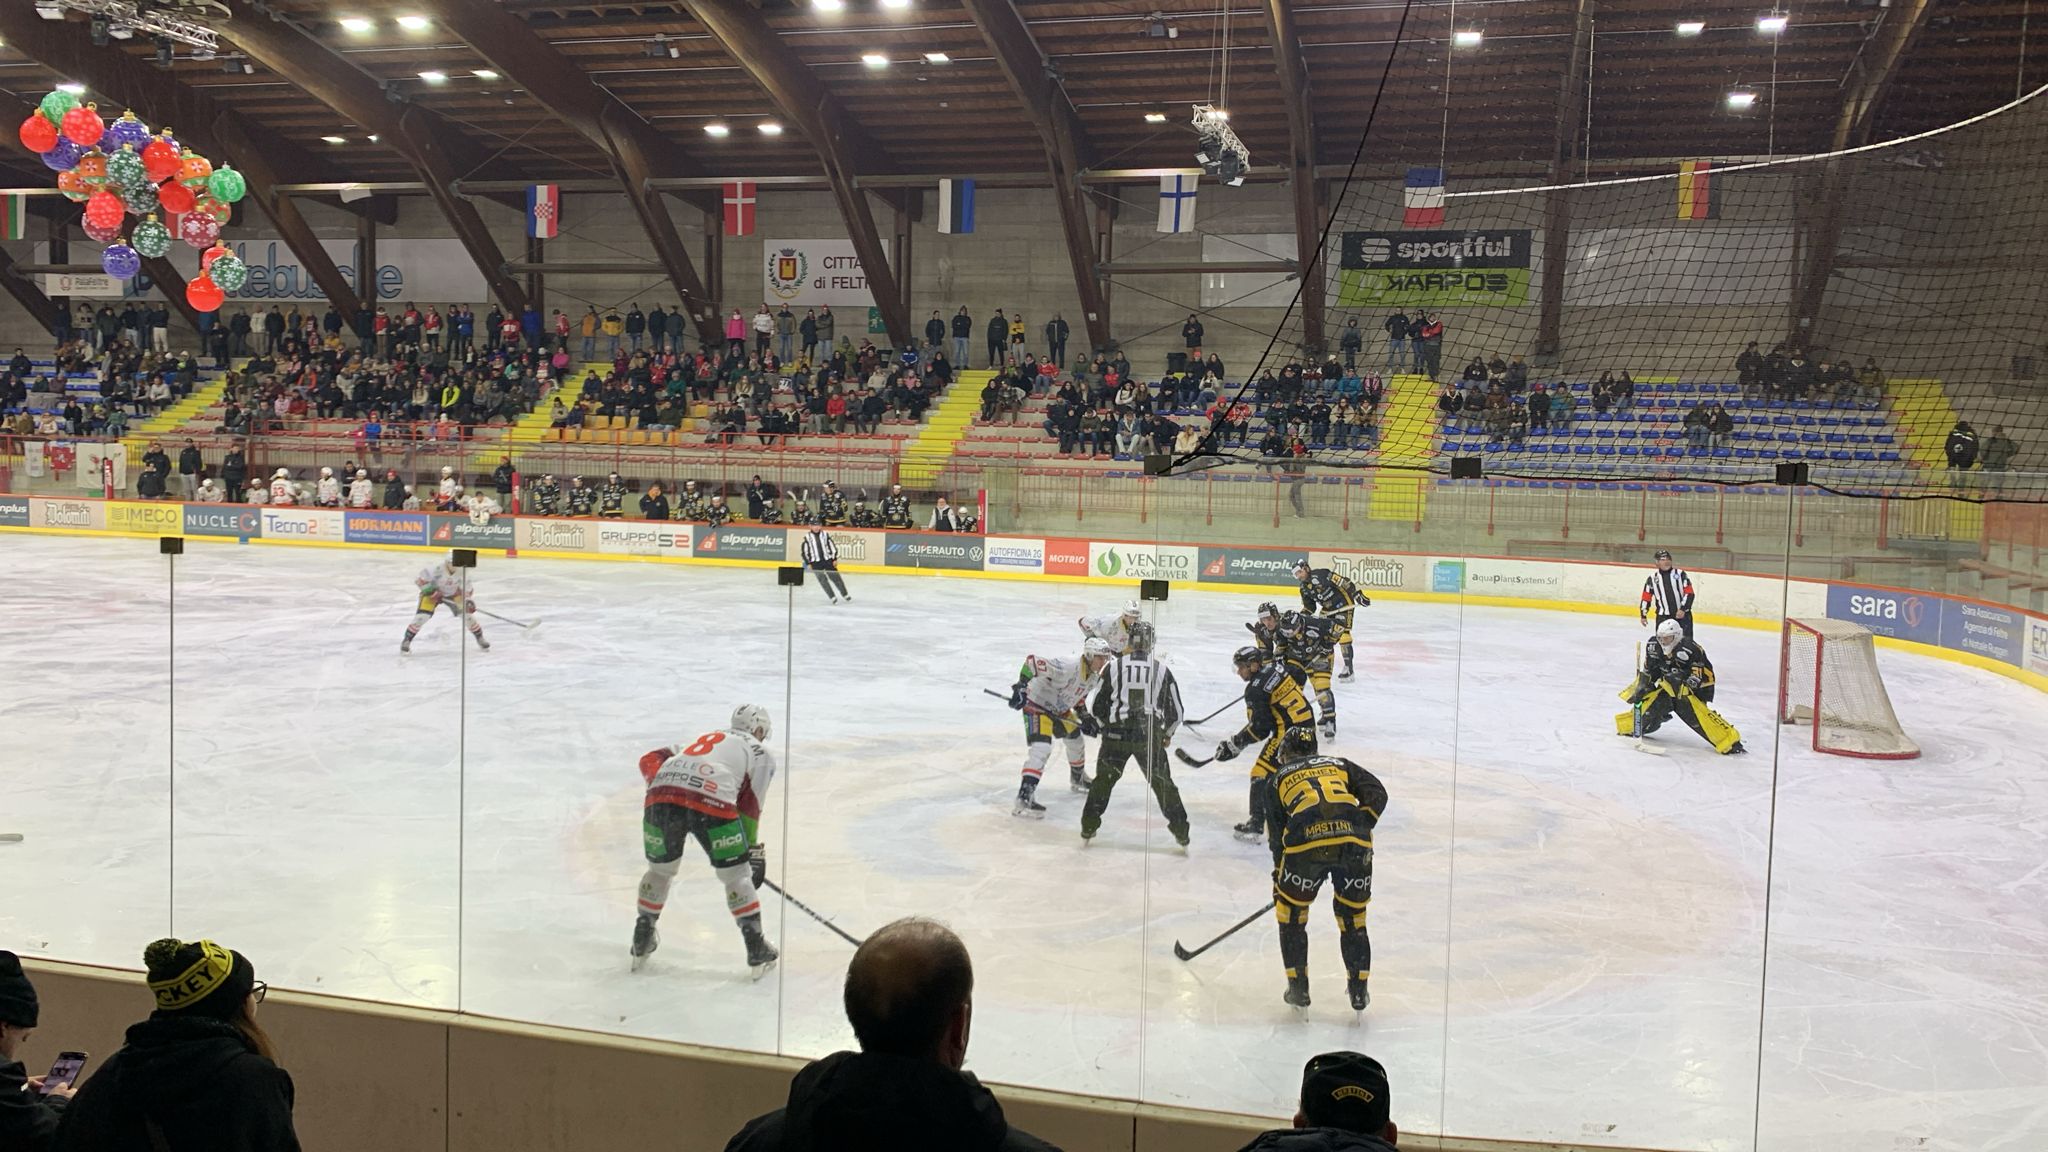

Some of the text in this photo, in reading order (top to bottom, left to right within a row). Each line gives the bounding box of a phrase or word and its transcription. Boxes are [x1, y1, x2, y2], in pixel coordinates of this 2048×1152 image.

[1397, 236, 1511, 262] sportful
[814, 277, 826, 289] di
[126, 508, 177, 524] IMECO
[454, 523, 512, 539] alpenplus
[529, 522, 584, 548] Dolomiti
[721, 533, 783, 546] alpenplus
[908, 544, 965, 556] SUPERAUTO
[1048, 554, 1086, 565] MOTRIO
[1126, 553, 1189, 569] VENETO
[1230, 557, 1294, 571] alpenplu
[1365, 556, 1385, 567] birra
[1546, 576, 1558, 585] Srl
[1850, 594, 1896, 620] sara
[1707, 712, 1729, 733] CCM
[683, 731, 726, 756] 8
[1306, 820, 1353, 836] MASTINI
[712, 833, 743, 849] nico
[156, 965, 214, 1002] CKEY
